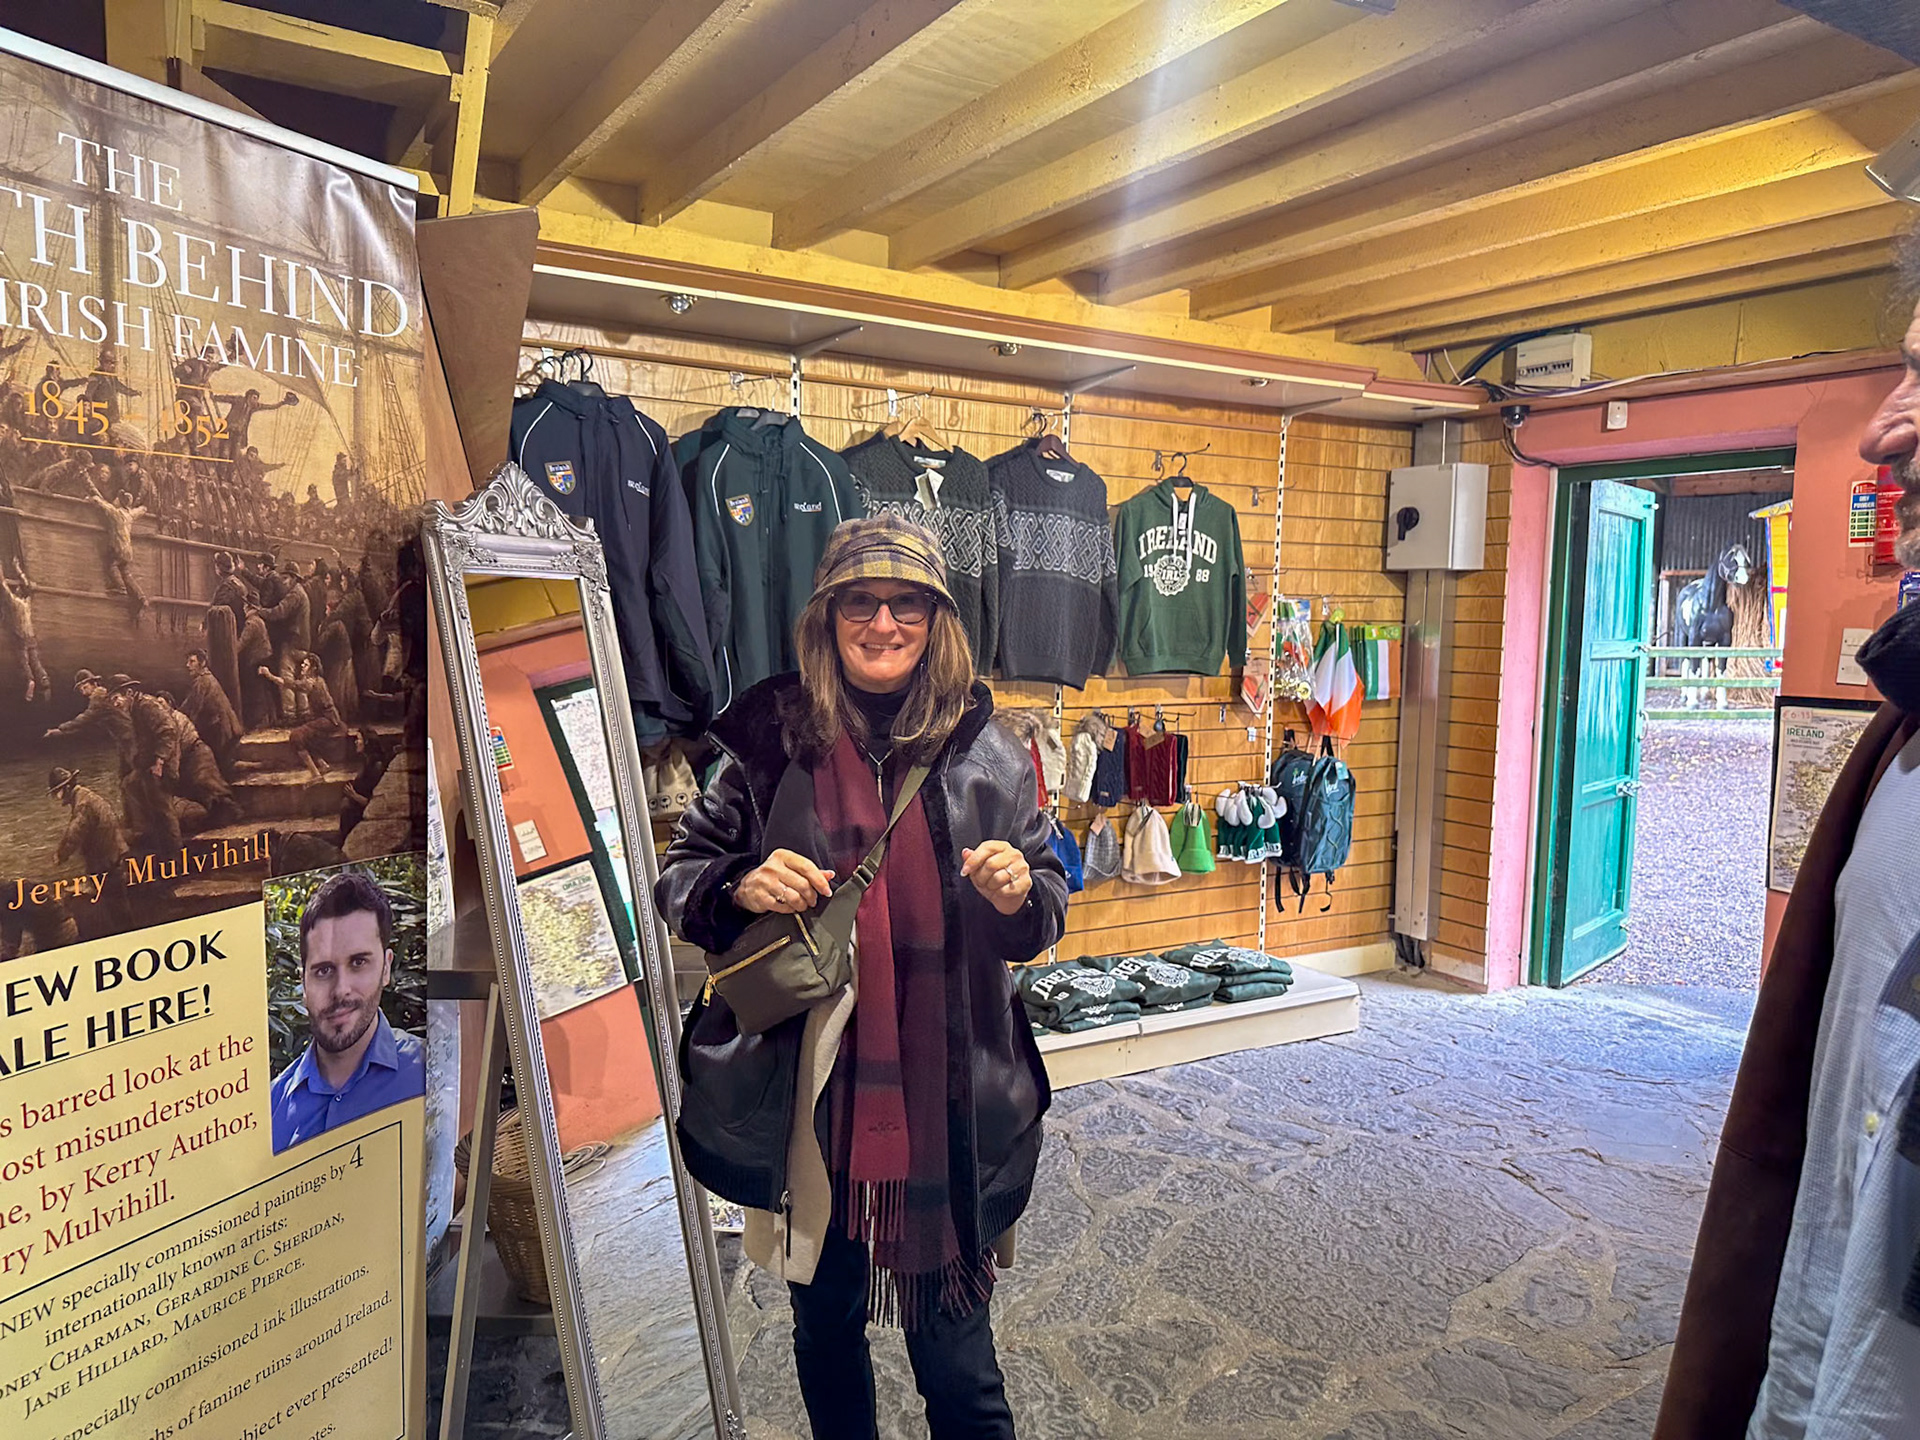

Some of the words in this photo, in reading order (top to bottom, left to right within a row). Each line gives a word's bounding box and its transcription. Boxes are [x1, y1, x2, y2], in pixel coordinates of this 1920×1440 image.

[58, 132, 183, 212] THE
[121, 217, 409, 338] BEHIND
[171, 313, 358, 388] FAMINE
[24, 380, 109, 436] 1845
[162, 400, 230, 448] 1852
[1786, 727, 1825, 739] IRELAND
[8, 872, 109, 910] Jerry
[125, 831, 271, 886] Mulvihill
[95, 930, 227, 992] BOOK
[86, 984, 210, 1049] HERE!
[20, 1073, 116, 1129] barred
[123, 1054, 183, 1095] look
[189, 1047, 211, 1071] at
[218, 1035, 253, 1061] the
[55, 1067, 250, 1163] misunderstood
[39, 1183, 75, 1213] by
[83, 1148, 162, 1195] Kerry
[168, 1112, 257, 1160] Author,
[0, 1297, 55, 1340] NEW
[62, 1261, 140, 1311] specially
[145, 1201, 260, 1269] commissioned
[264, 1173, 327, 1217] paintings
[330, 1164, 346, 1180] by
[349, 1144, 364, 1169] 4
[2, 1243, 34, 1275] ry
[43, 1178, 174, 1256] Mulvihill.
[45, 1270, 178, 1347] internationally
[181, 1242, 236, 1279] known
[241, 1217, 287, 1249] artists:
[50, 1314, 151, 1371] CHARMAN,
[156, 1261, 249, 1316] GERARDINE
[253, 1249, 269, 1266] C.
[273, 1212, 345, 1257] SHERIDAN,
[25, 1381, 71, 1420] JANE
[77, 1333, 168, 1387] HILLIARD,
[172, 1288, 247, 1337] MAURICE
[251, 1259, 305, 1295] PIERCE.
[61, 1394, 140, 1440] specially
[145, 1323, 259, 1400] commissioned
[263, 1309, 286, 1333] ink
[290, 1266, 369, 1318] illustrations.
[178, 1406, 195, 1430] of
[199, 1379, 251, 1419] famine
[255, 1354, 291, 1384] ruins
[295, 1318, 342, 1359] around
[345, 1290, 392, 1328] Ireland.
[286, 1388, 318, 1417] ever
[321, 1336, 392, 1399] presented!
